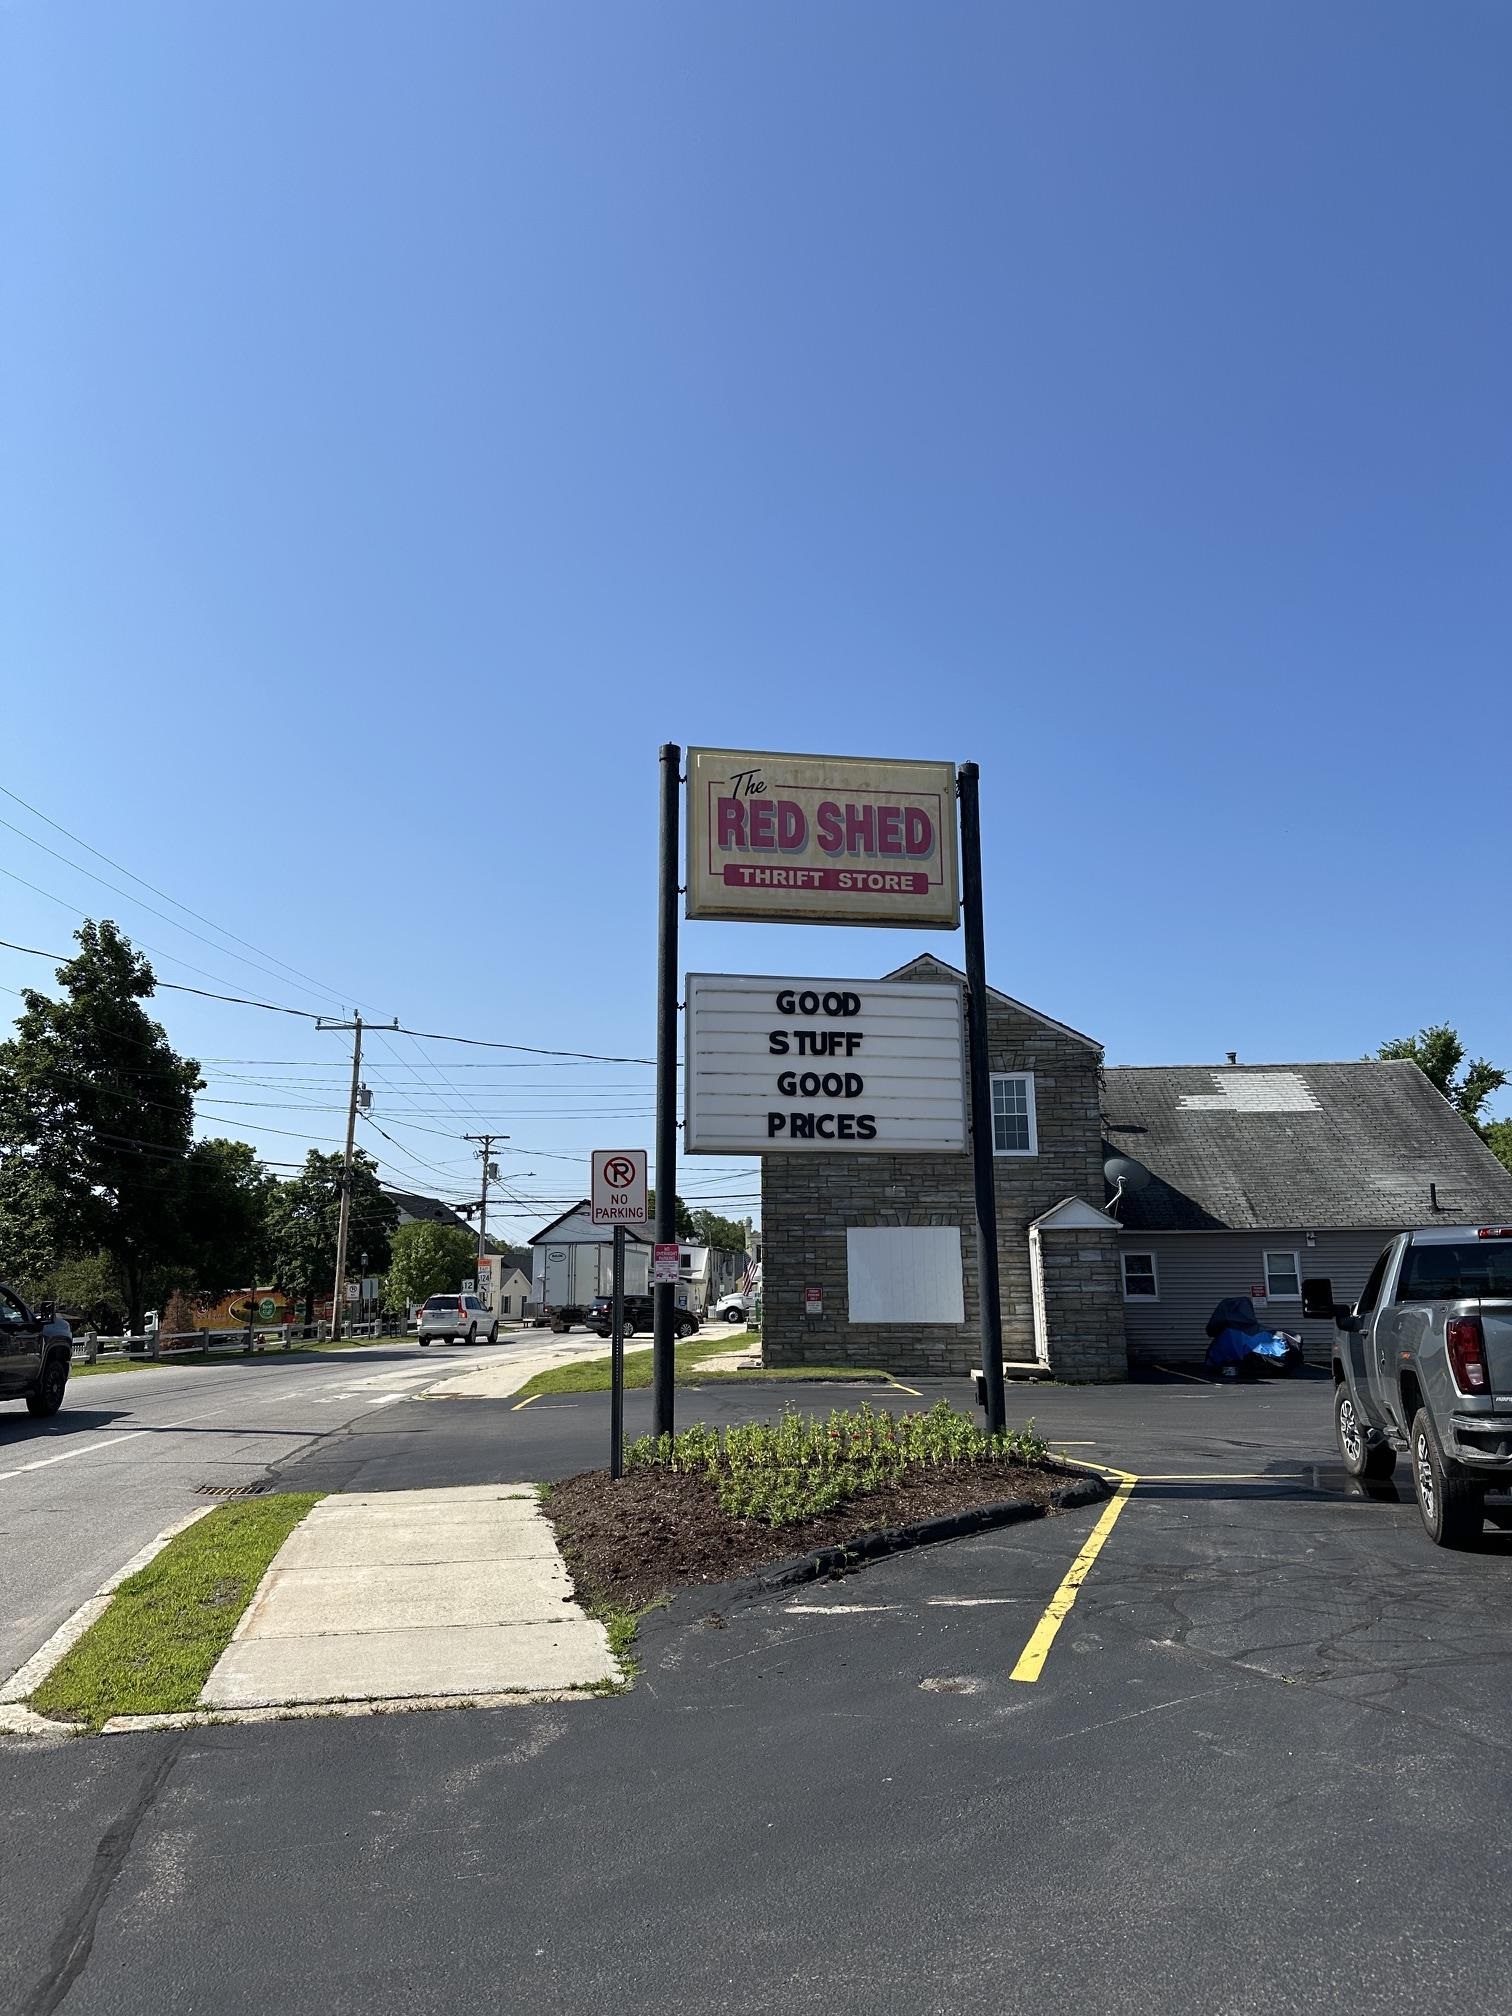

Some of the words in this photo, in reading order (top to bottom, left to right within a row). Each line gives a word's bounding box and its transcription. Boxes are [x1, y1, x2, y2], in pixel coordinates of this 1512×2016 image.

[730, 768, 768, 800] The
[717, 797, 808, 853] RED
[816, 801, 935, 860] SHED
[739, 868, 824, 888] THRIFT
[838, 873, 915, 891] STORE
[776, 990, 861, 1016] GOOD
[769, 1030, 863, 1057] STUFF
[777, 1071, 864, 1098] GOOD
[768, 1112, 877, 1140] PRICES
[611, 1194, 628, 1205] NO
[595, 1207, 644, 1219] PARKING
[464, 1281, 473, 1290] 12
